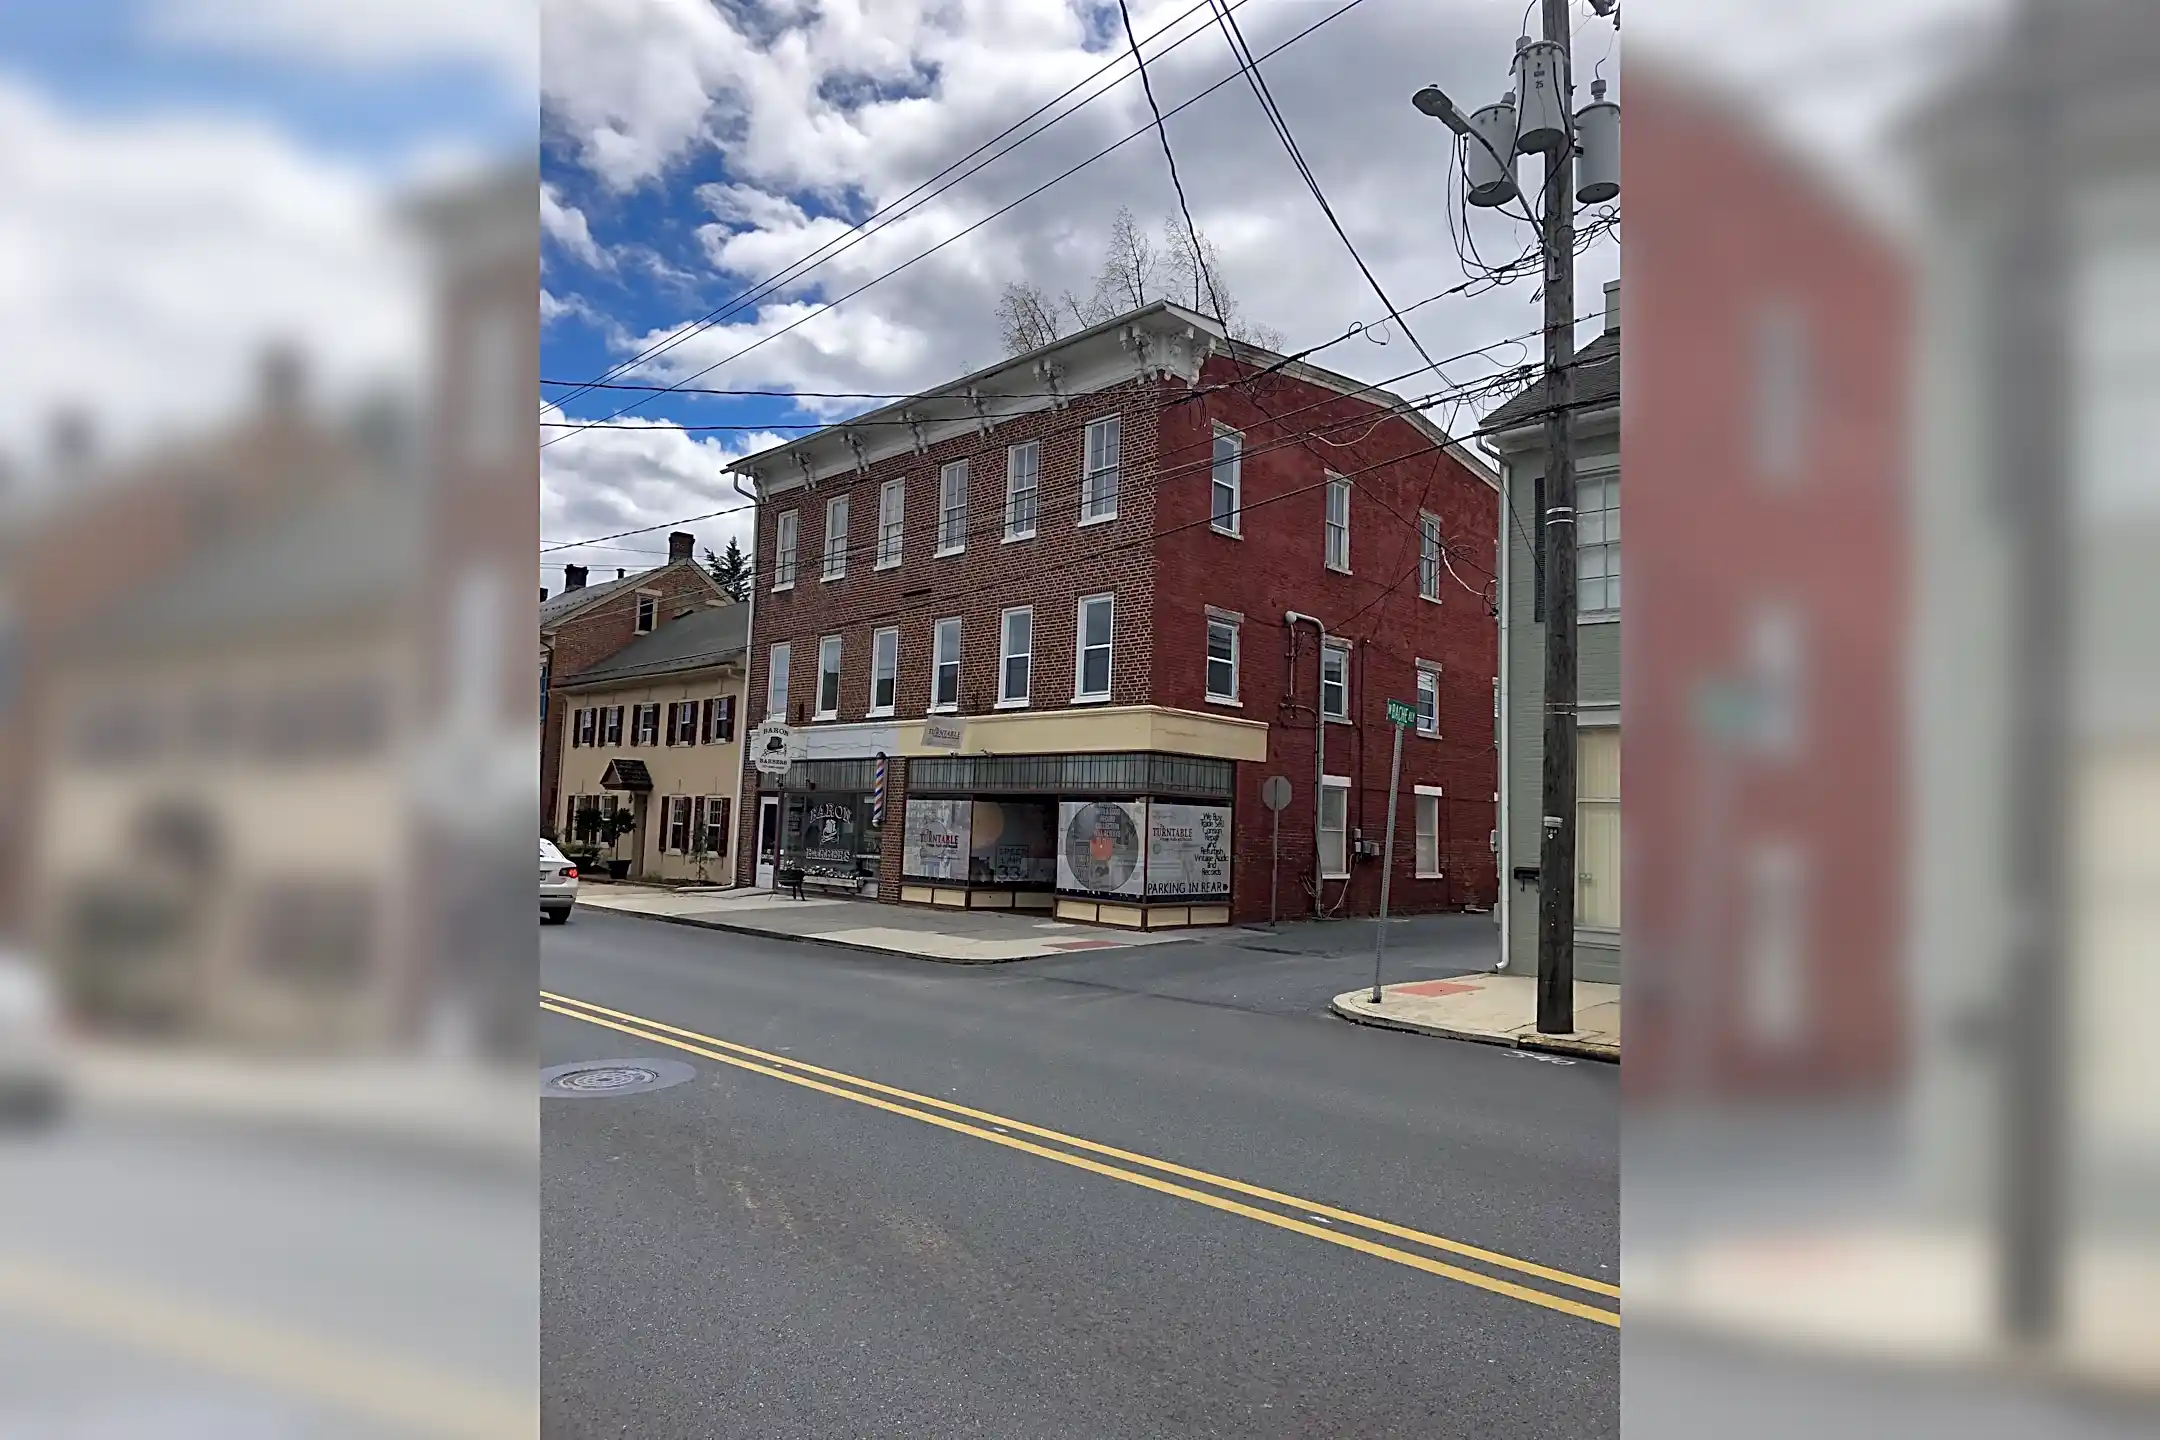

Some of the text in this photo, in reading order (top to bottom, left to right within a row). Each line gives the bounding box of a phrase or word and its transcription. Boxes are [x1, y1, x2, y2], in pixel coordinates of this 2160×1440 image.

[1536, 80, 1544, 88] 25
[764, 728, 788, 736] BARON
[810, 803, 852, 824] BARON
[1212, 812, 1222, 821] Buy
[1152, 828, 1193, 838] TURNTABLE
[920, 833, 959, 844] TURNTABLE
[806, 848, 851, 862] BARBERS
[1202, 868, 1222, 876] Records
[1148, 882, 1222, 894] PARKING IN REAR
